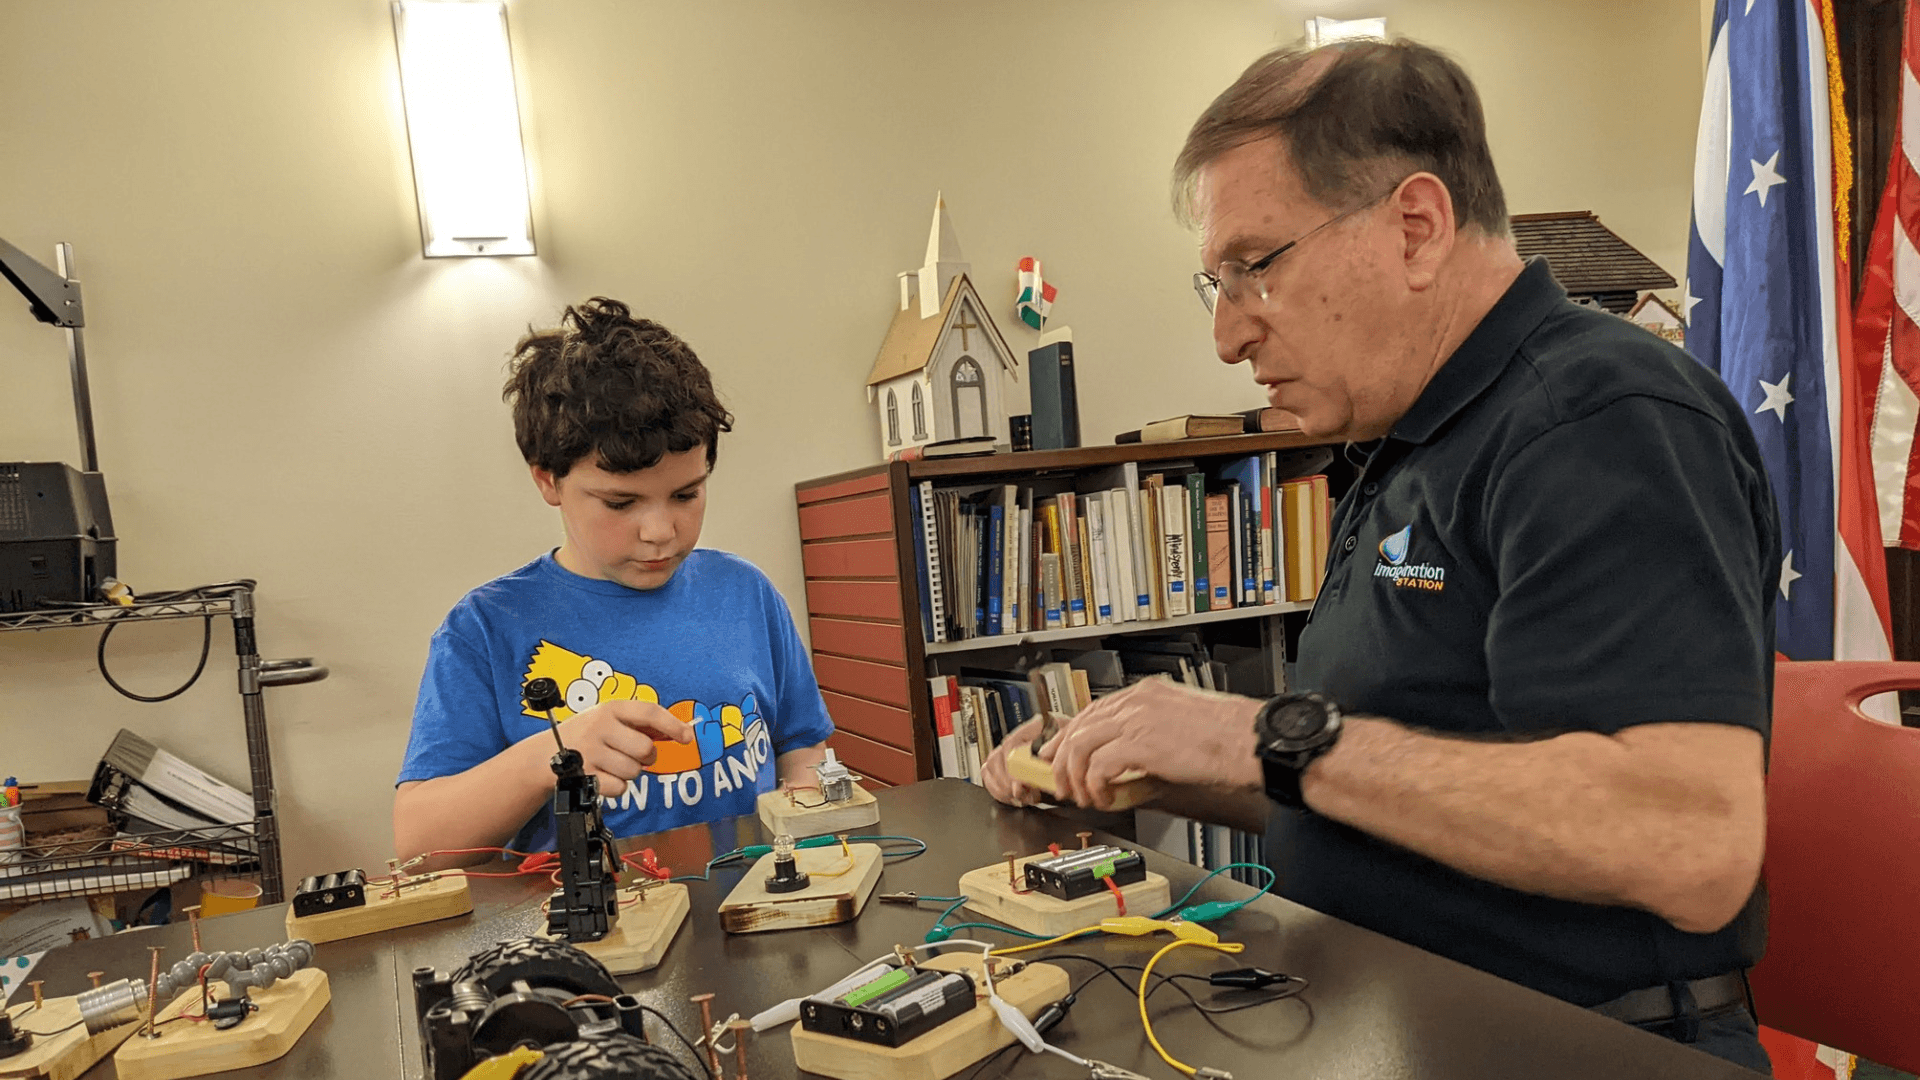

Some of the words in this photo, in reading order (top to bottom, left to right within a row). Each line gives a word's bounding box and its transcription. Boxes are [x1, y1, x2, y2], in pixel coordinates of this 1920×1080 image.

[1165, 533, 1184, 578] Mindszenty
[1396, 577, 1444, 591] STATION
[657, 769, 703, 809] TO
